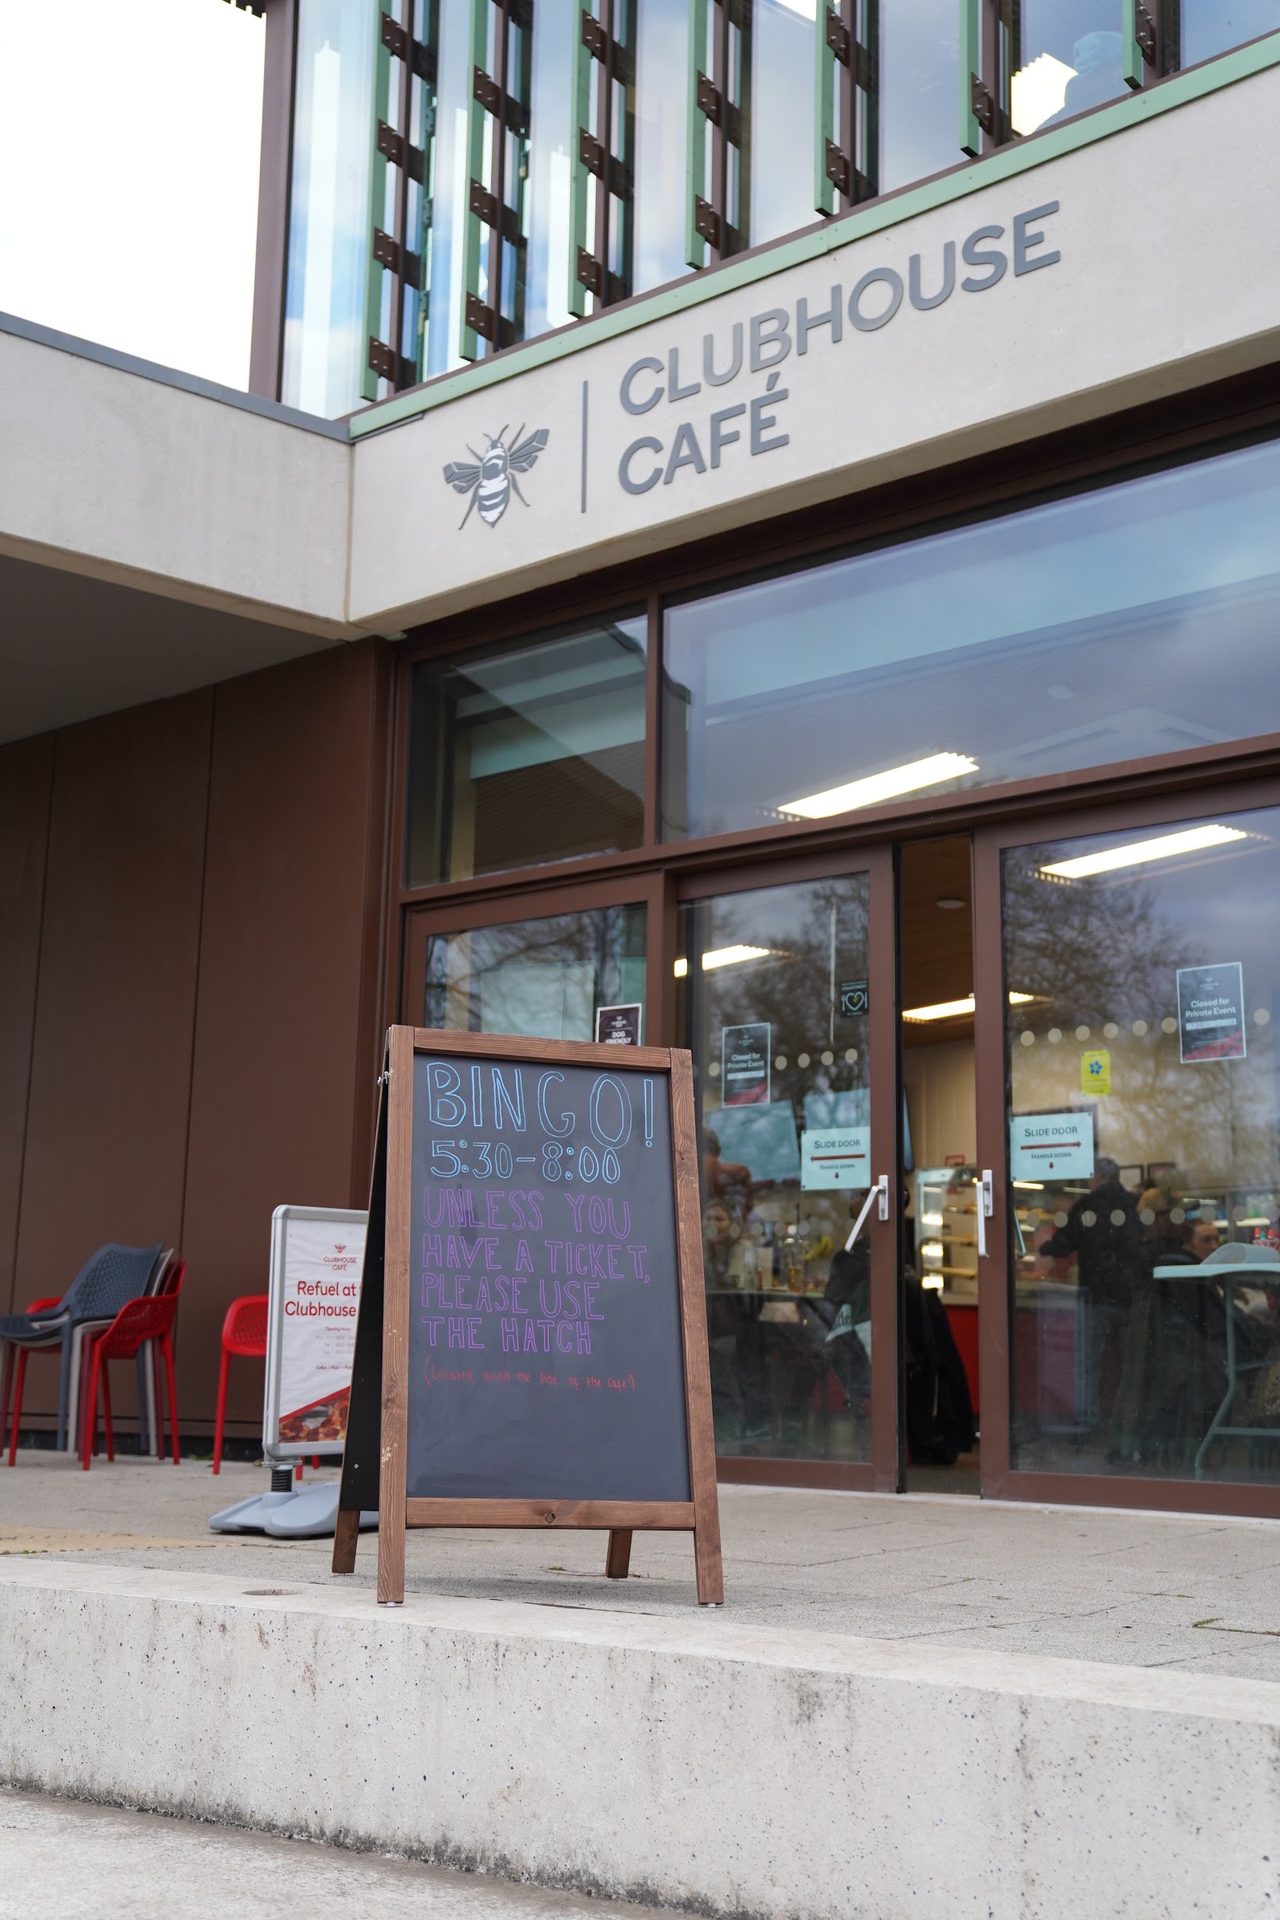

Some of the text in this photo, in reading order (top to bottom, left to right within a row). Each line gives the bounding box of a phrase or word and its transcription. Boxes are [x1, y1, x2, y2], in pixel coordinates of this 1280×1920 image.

[618, 200, 1062, 415] CLUBHOUSE
[618, 371, 790, 495] CAFÉ
[1185, 1006, 1236, 1018] Private Event
[1190, 997, 1230, 1008] Closed for
[426, 1062, 654, 1149] BINGO!
[837, 1139, 861, 1148] DOOR
[1024, 1126, 1078, 1137] SLIDE DOOR
[422, 1186, 632, 1240] UNLESS YOU
[323, 1256, 357, 1264] CLUBHOUSE
[422, 1234, 651, 1284] HAVE A TICKET,
[297, 1280, 340, 1297] Refuel
[342, 1283, 357, 1297] at
[421, 1273, 605, 1321] PLEASE USE
[284, 1300, 357, 1317] Clubhouse
[421, 1316, 593, 1355] THE HATCH
